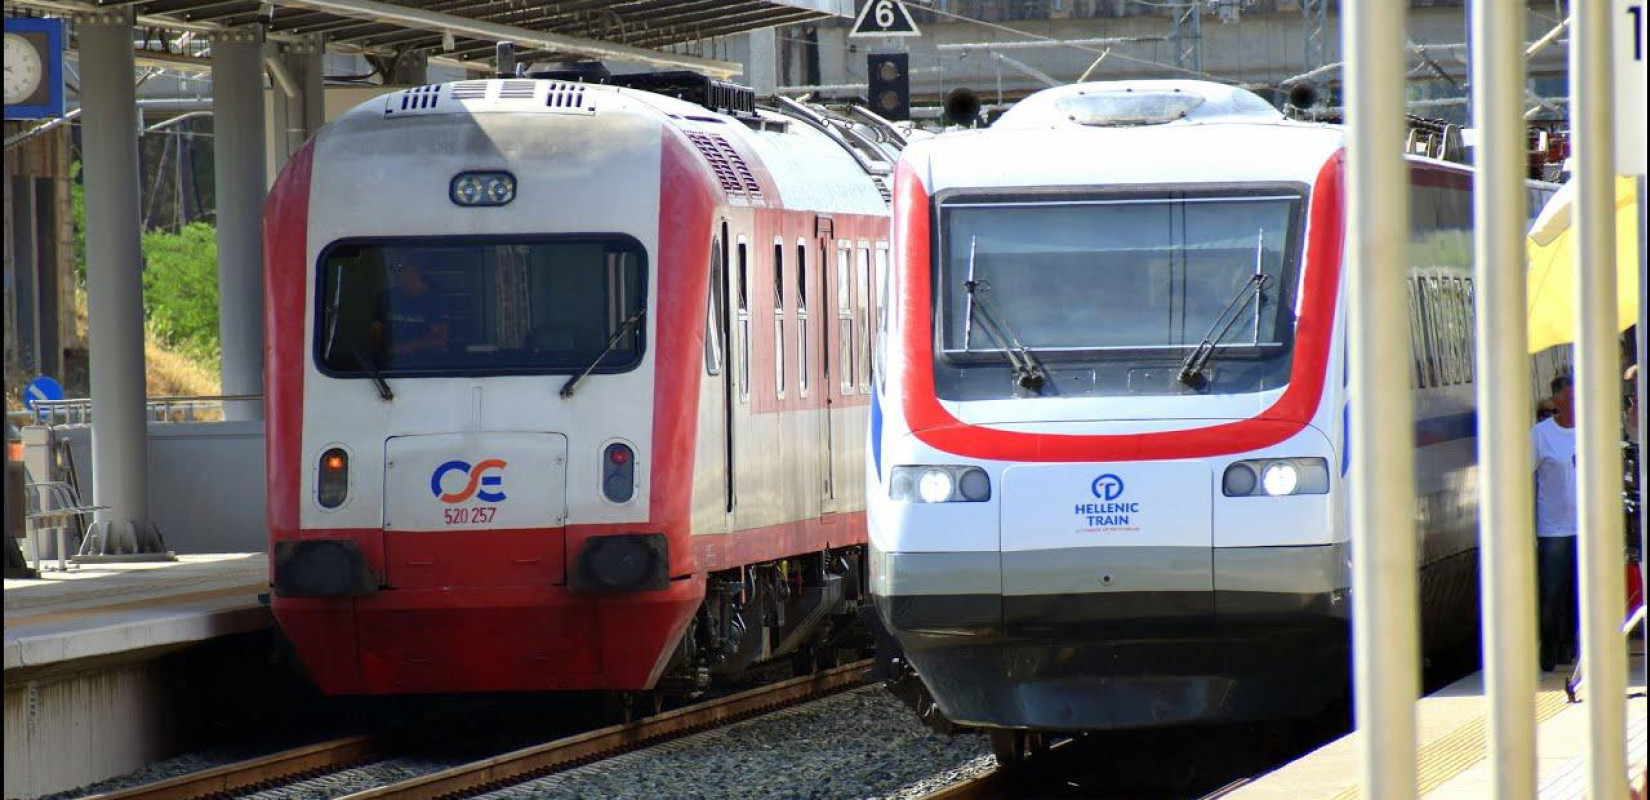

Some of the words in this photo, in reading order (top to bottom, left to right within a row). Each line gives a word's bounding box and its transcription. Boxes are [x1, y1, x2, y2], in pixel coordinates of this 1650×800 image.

[876, 0, 894, 27] 6
[1625, 6, 1642, 61] 1
[444, 508, 468, 524] 520
[471, 507, 496, 524] 257
[1075, 502, 1139, 514] HELLENIC
[1086, 515, 1129, 526] TRAIN
